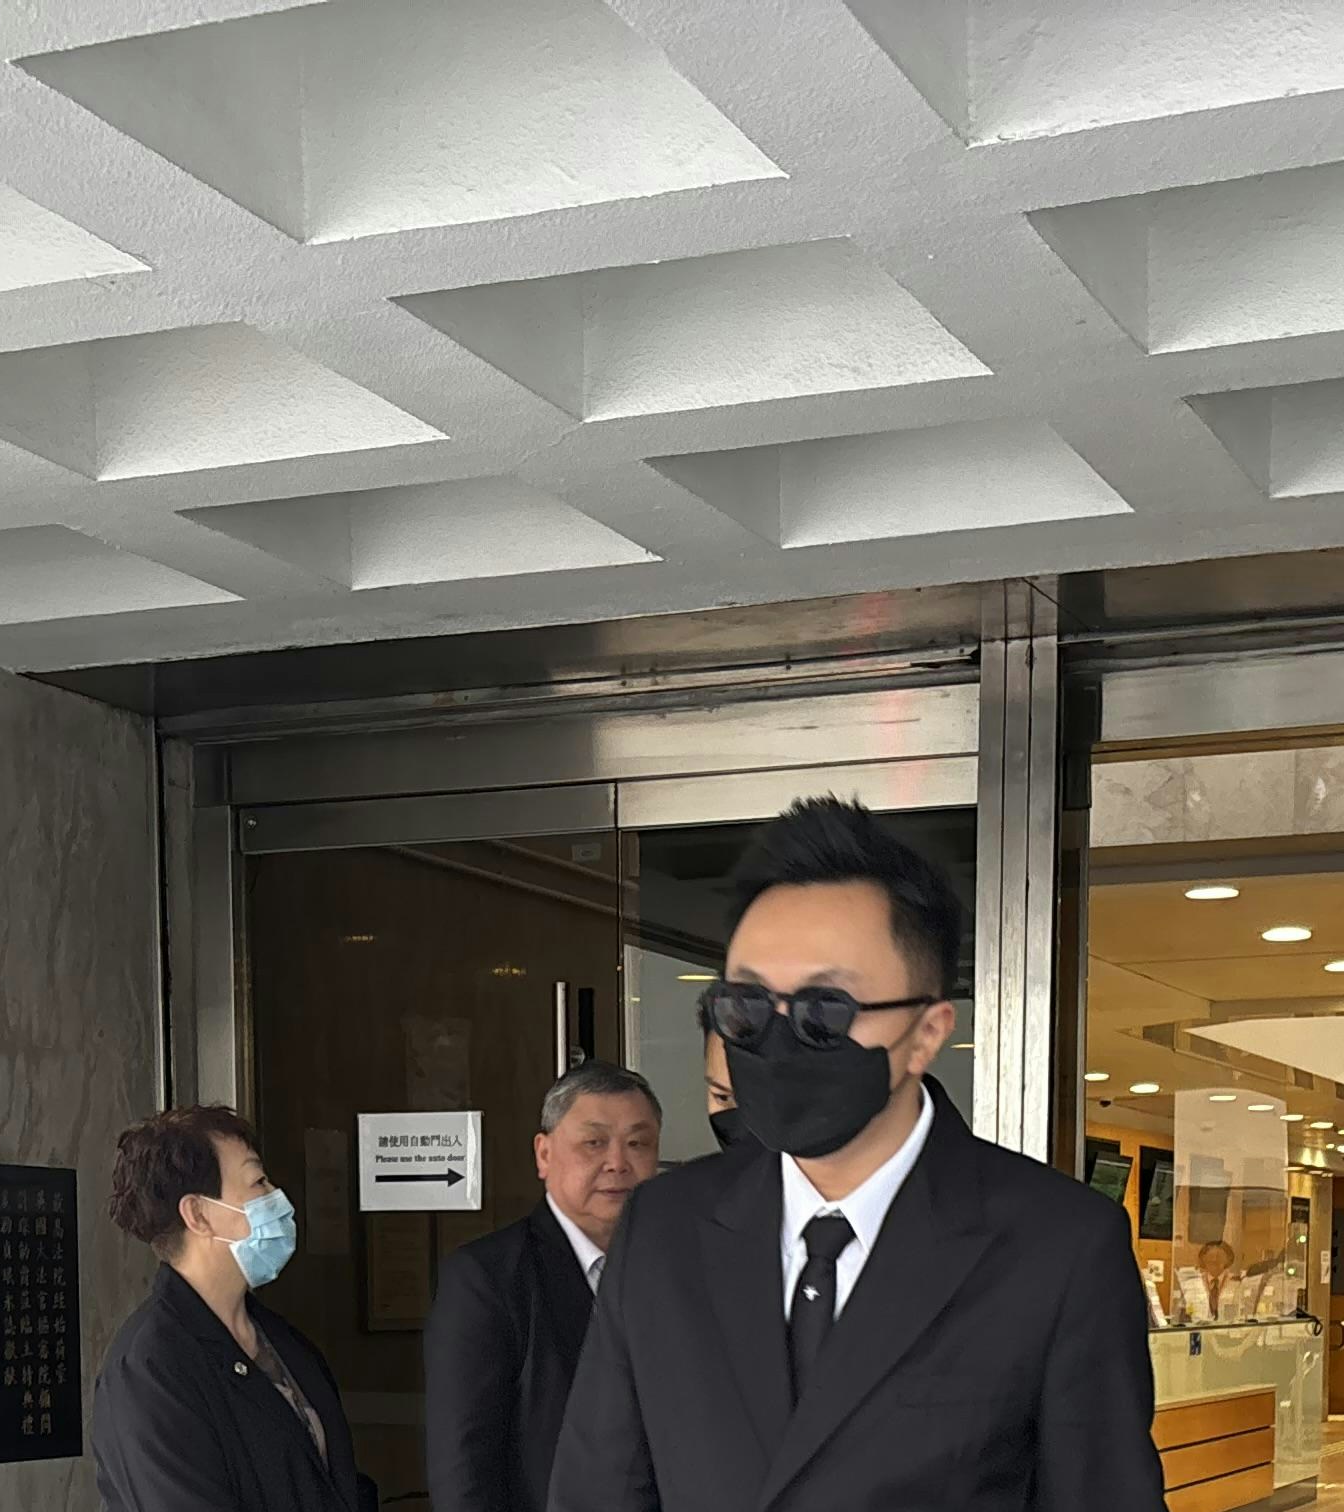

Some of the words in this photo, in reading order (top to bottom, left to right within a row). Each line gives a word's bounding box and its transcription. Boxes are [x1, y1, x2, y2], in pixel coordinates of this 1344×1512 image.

[378, 1134, 463, 1148] 請使用自動門出入
[376, 1155, 398, 1163] Please
[414, 1154, 426, 1162] the
